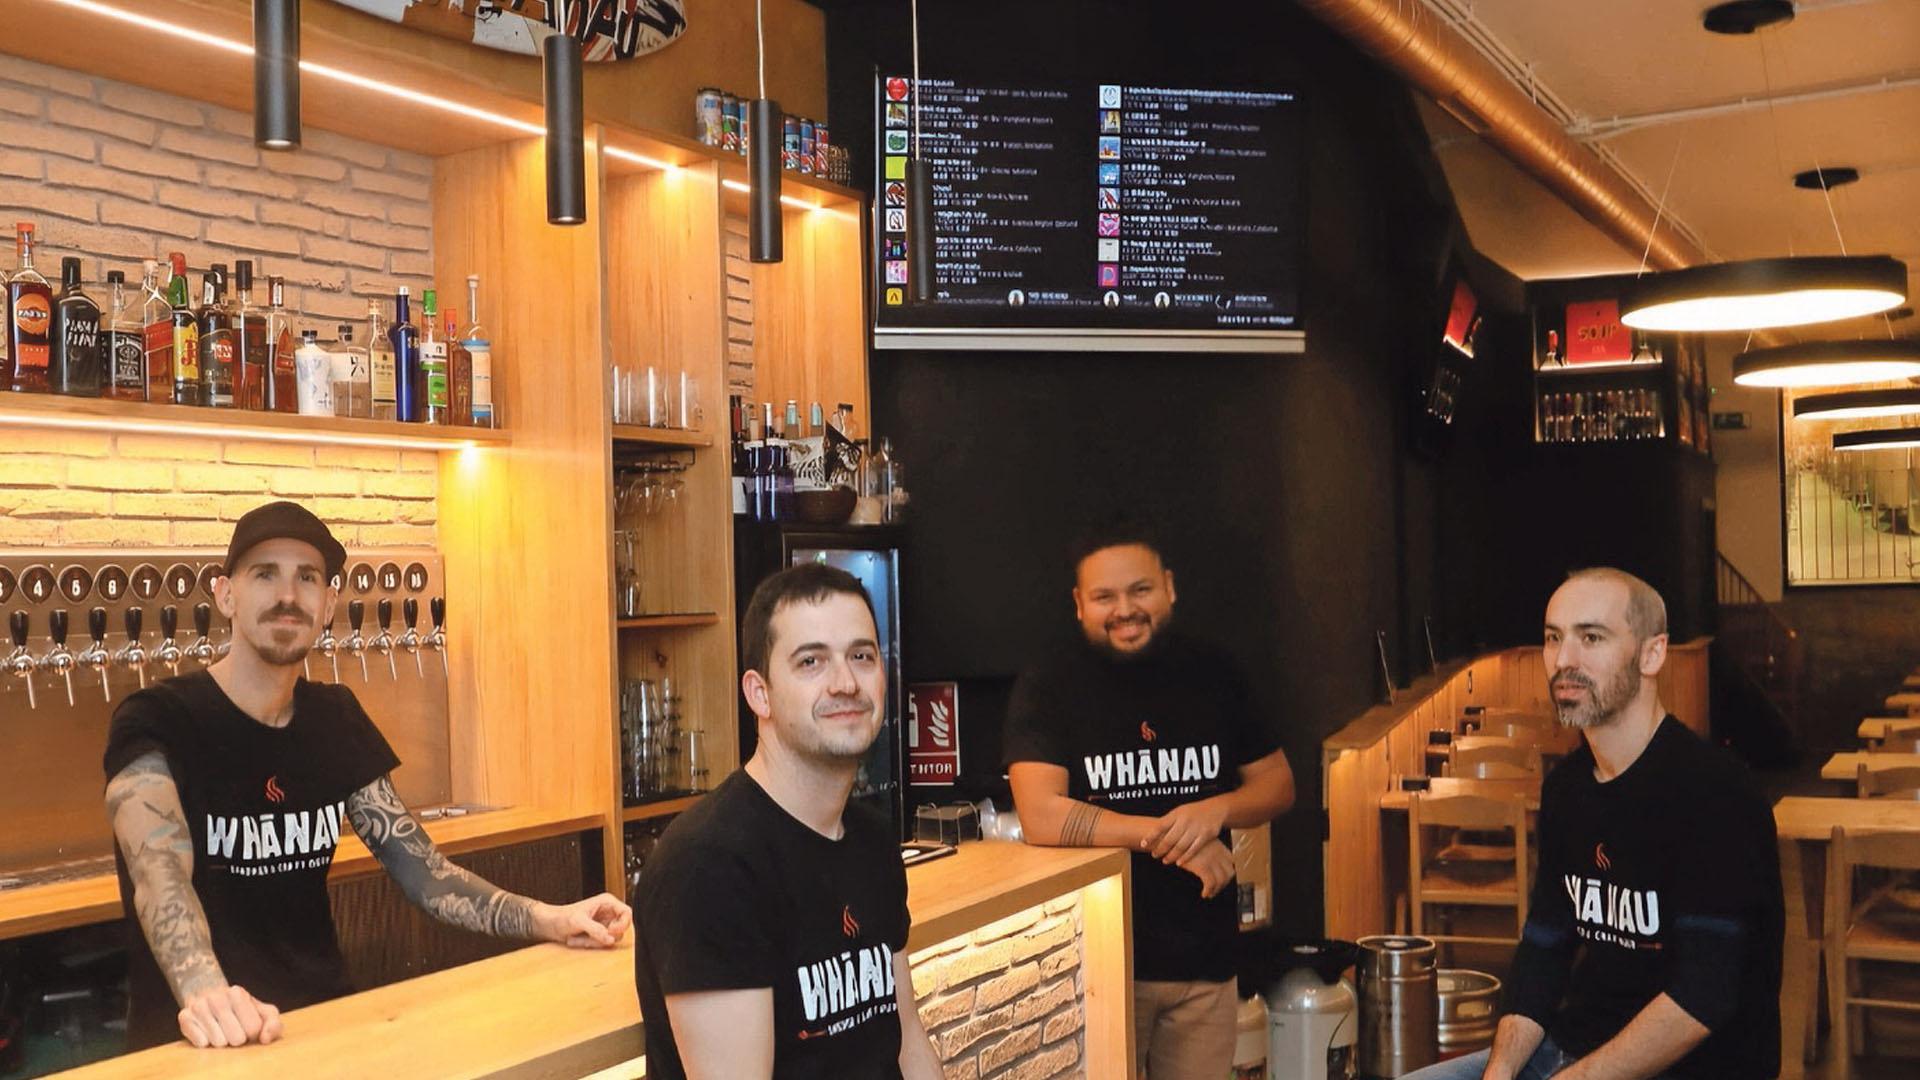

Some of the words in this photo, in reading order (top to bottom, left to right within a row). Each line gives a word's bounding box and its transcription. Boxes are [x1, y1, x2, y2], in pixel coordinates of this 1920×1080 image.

[33, 579, 43, 597] 4
[142, 579, 152, 596] 7
[177, 577, 186, 595] 8
[1083, 744, 1221, 791] WHĀNAU
